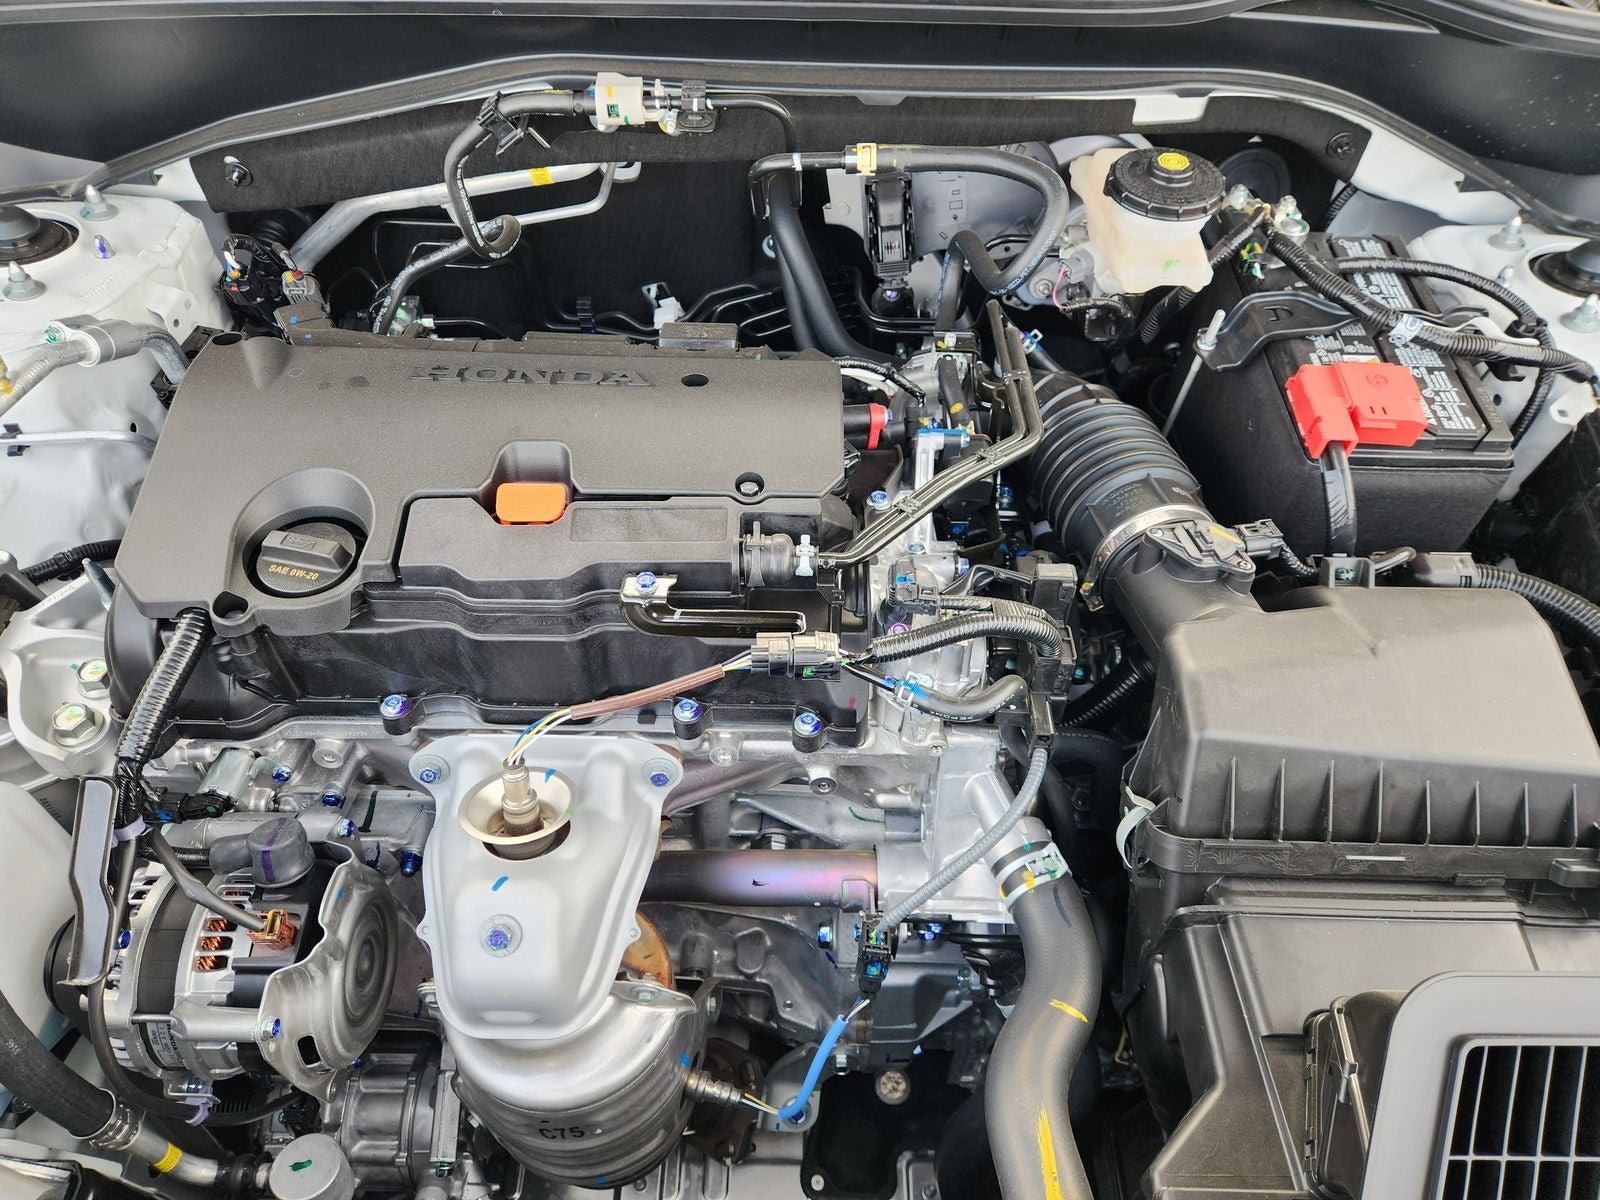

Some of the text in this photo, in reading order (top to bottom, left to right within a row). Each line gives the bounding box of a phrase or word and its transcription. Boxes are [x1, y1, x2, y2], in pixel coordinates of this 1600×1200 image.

[410, 364, 653, 387] HONDA
[268, 564, 320, 581] SAE 0W-20
[5, 1038, 21, 1055] 0146
[539, 1126, 586, 1139] C75
